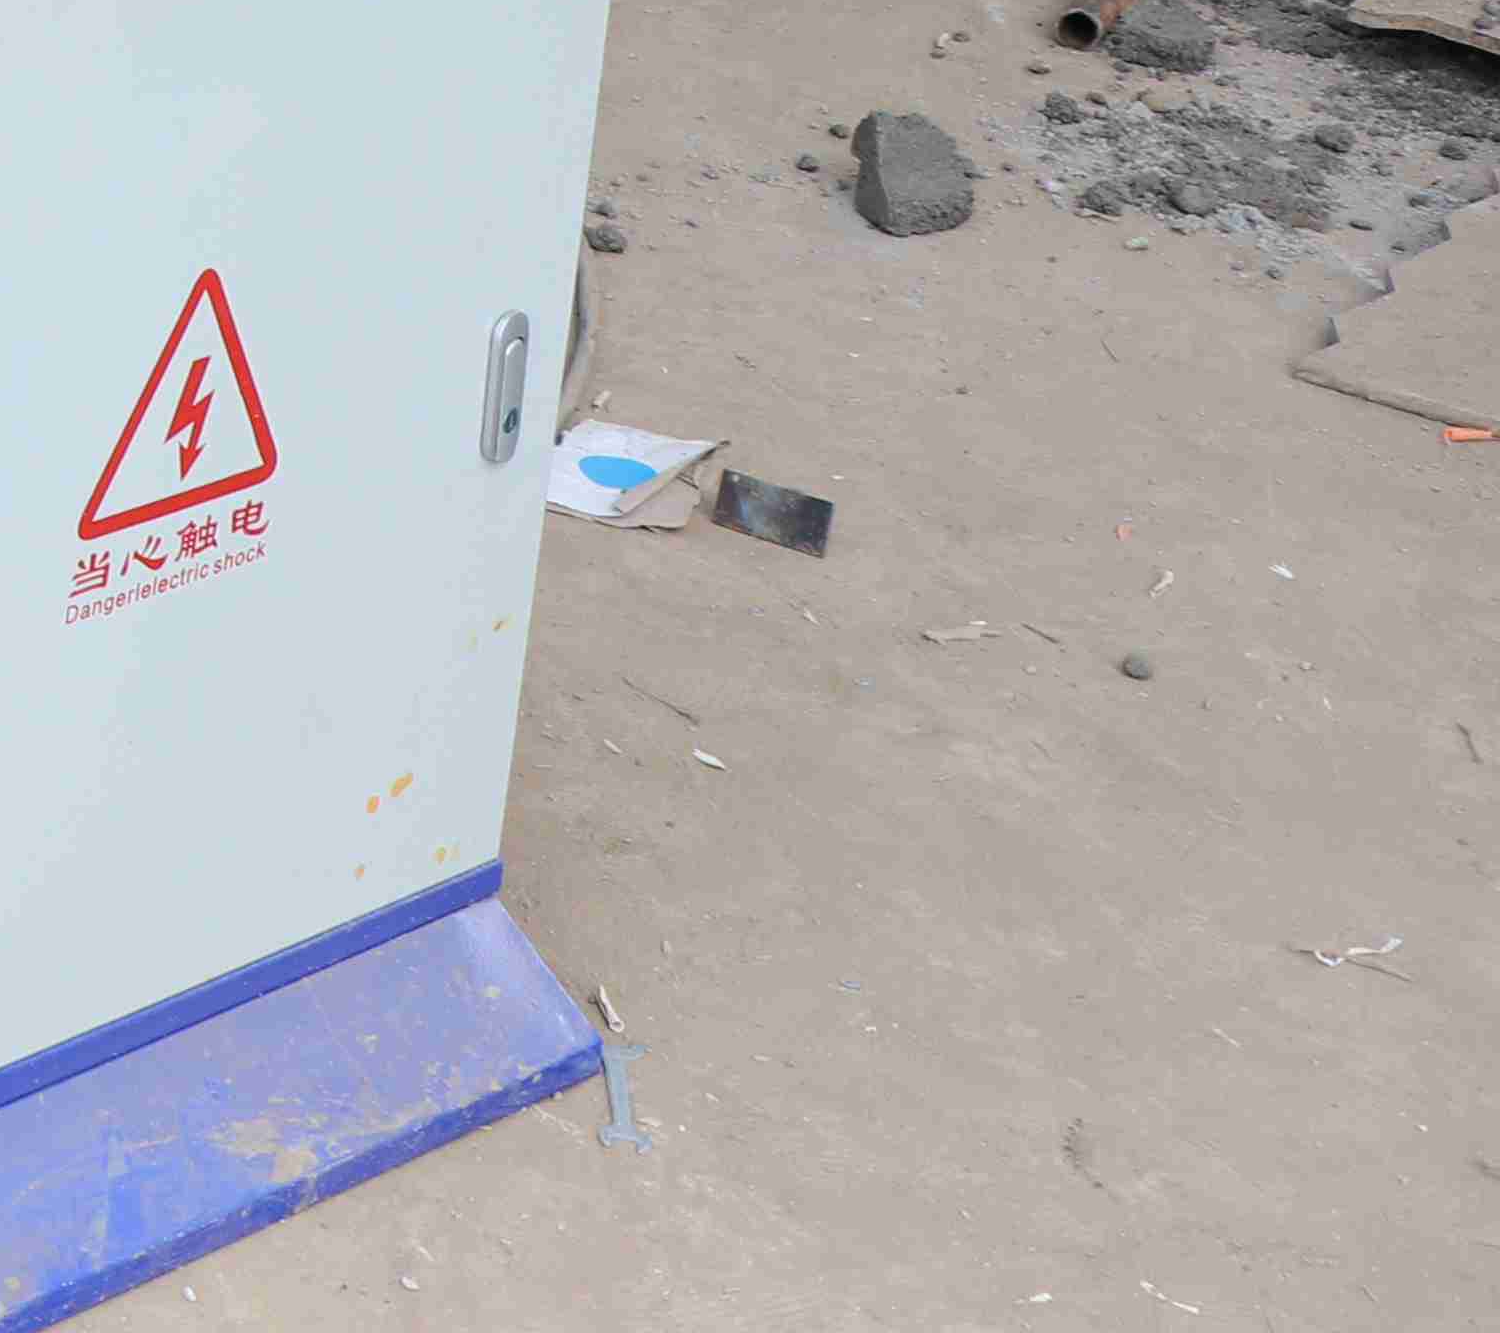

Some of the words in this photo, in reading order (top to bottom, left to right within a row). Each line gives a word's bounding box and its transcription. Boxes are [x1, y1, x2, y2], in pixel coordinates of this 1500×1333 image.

[69, 500, 270, 598] 当心触电
[212, 541, 268, 575] shock
